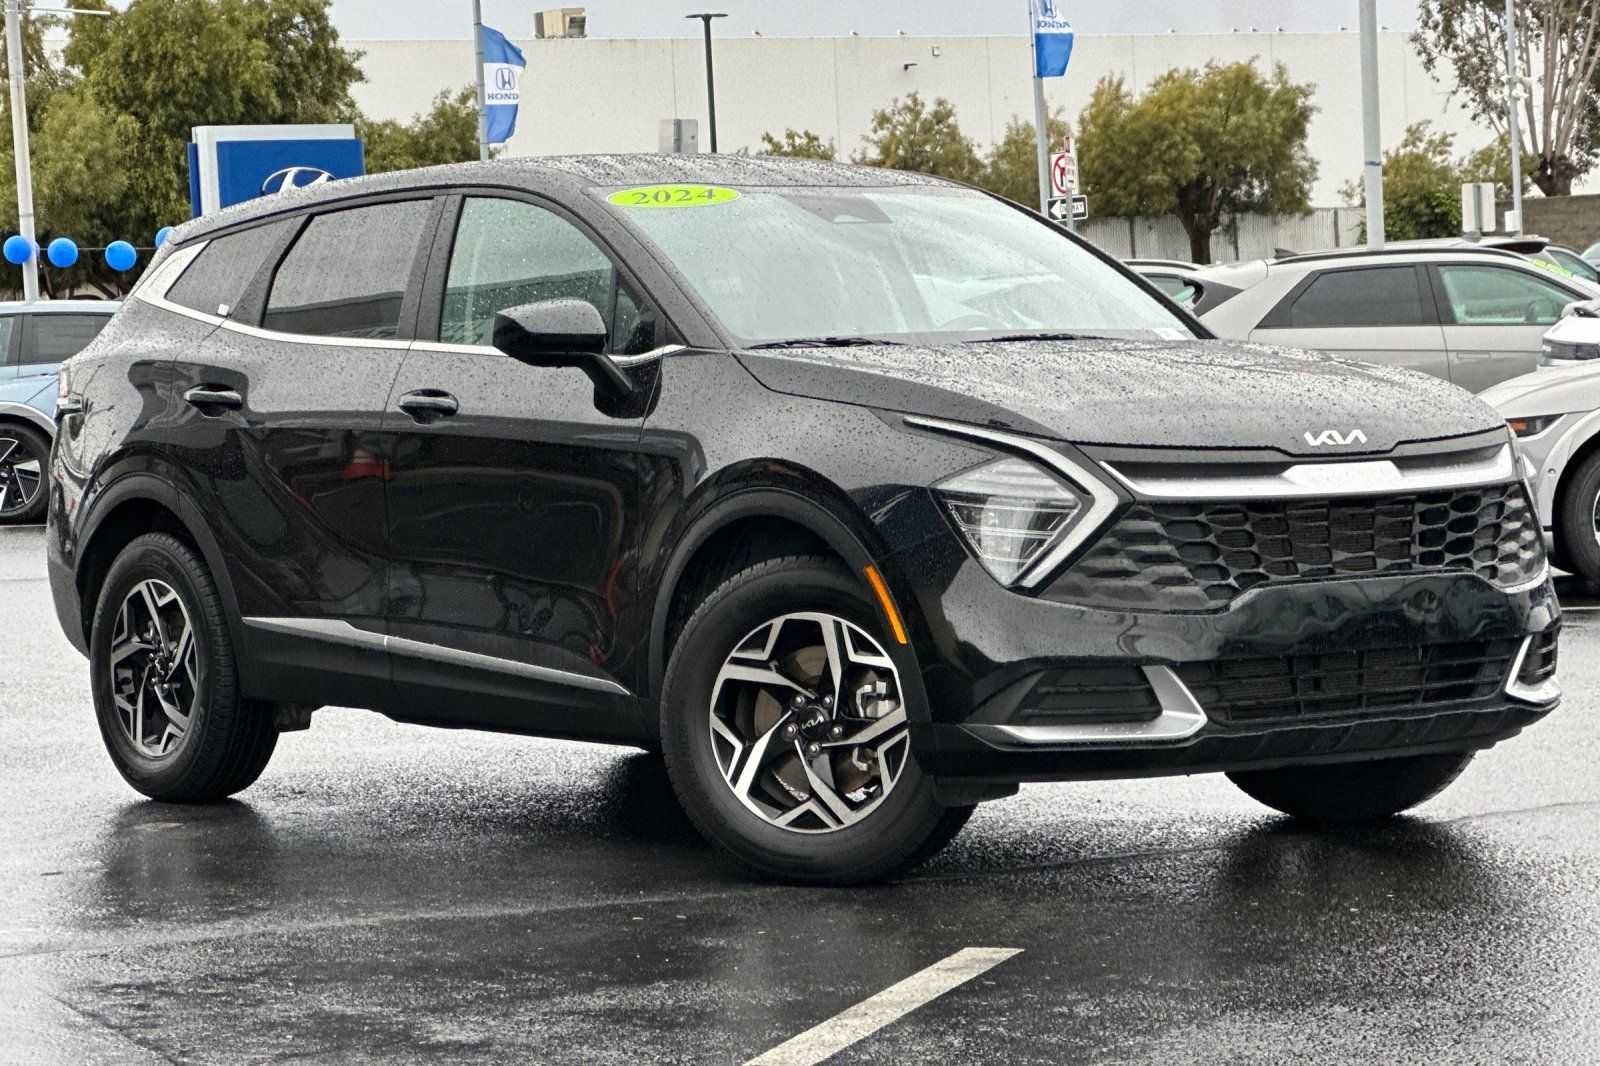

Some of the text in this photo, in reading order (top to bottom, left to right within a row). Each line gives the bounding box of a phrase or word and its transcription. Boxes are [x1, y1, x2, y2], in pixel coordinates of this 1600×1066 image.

[487, 92, 519, 101] HOND
[631, 187, 716, 205] 2024
[1303, 429, 1368, 446] KIA
